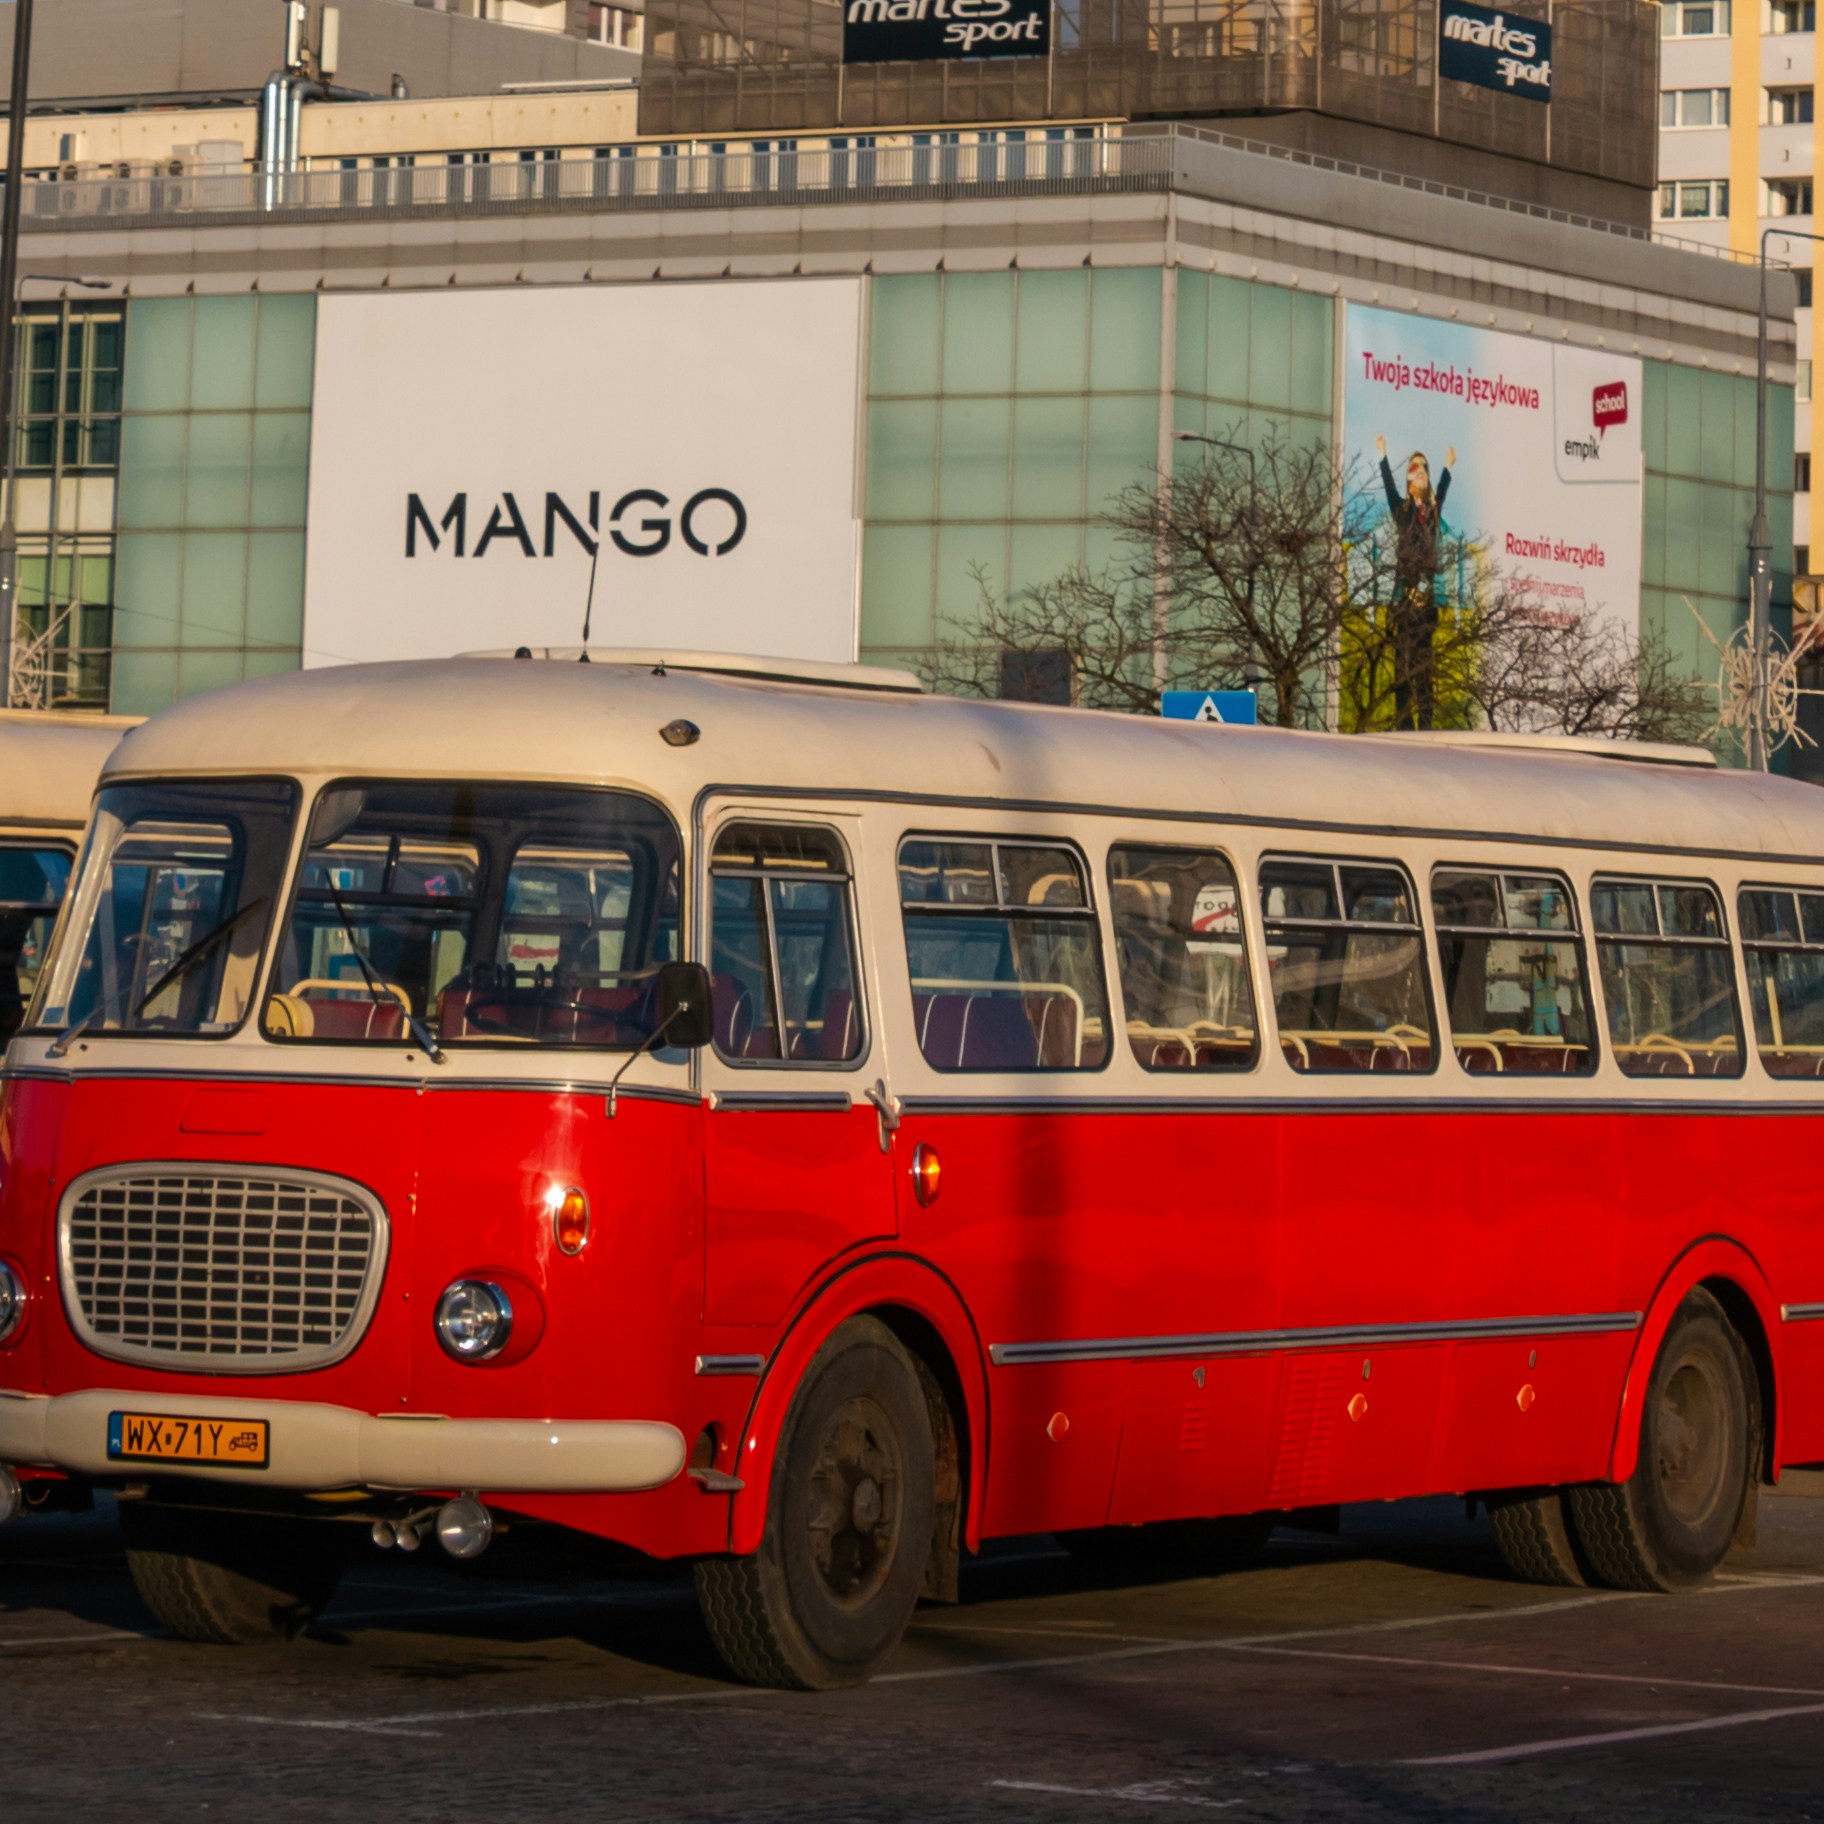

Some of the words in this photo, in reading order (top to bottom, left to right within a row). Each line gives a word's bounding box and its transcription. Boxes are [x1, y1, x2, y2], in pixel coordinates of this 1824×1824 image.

[943, 10, 1044, 51] sport
[1444, 12, 1537, 59] martes
[1497, 55, 1551, 89] sport
[1362, 351, 1410, 389] Twoja
[1414, 360, 1463, 397] szkoła
[1466, 367, 1539, 409] językowa
[1595, 392, 1626, 414] school
[1564, 434, 1600, 462] empik
[405, 487, 747, 558] MANGO
[1506, 532, 1551, 560] Rozwiń
[1554, 538, 1605, 569] skrzydła
[128, 1419, 163, 1453] WX
[174, 1422, 223, 1456] 71Y
